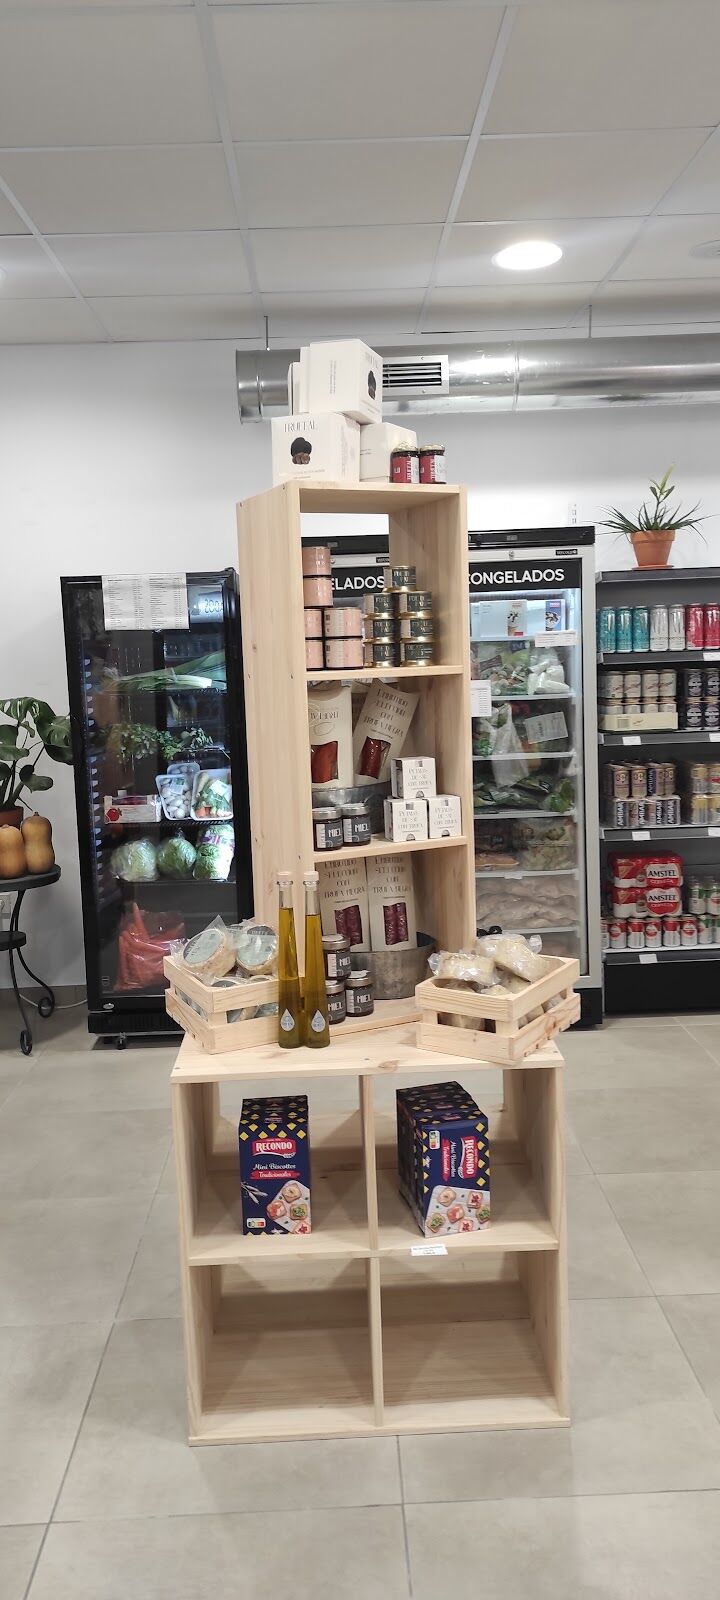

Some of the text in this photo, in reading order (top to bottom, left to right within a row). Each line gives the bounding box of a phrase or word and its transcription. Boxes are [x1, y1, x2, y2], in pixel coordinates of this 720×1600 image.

[468, 569, 565, 585] ONGELADOS
[328, 828, 342, 838] MIEL
[354, 823, 369, 833] MIEL
[647, 870, 677, 878] AMSTEL
[648, 894, 676, 902] AMSTEL
[357, 994, 372, 1004] MIEL
[327, 1001, 343, 1012] MIEL
[255, 1142, 293, 1152] RECONDO
[464, 1139, 475, 1175] RECONDO
